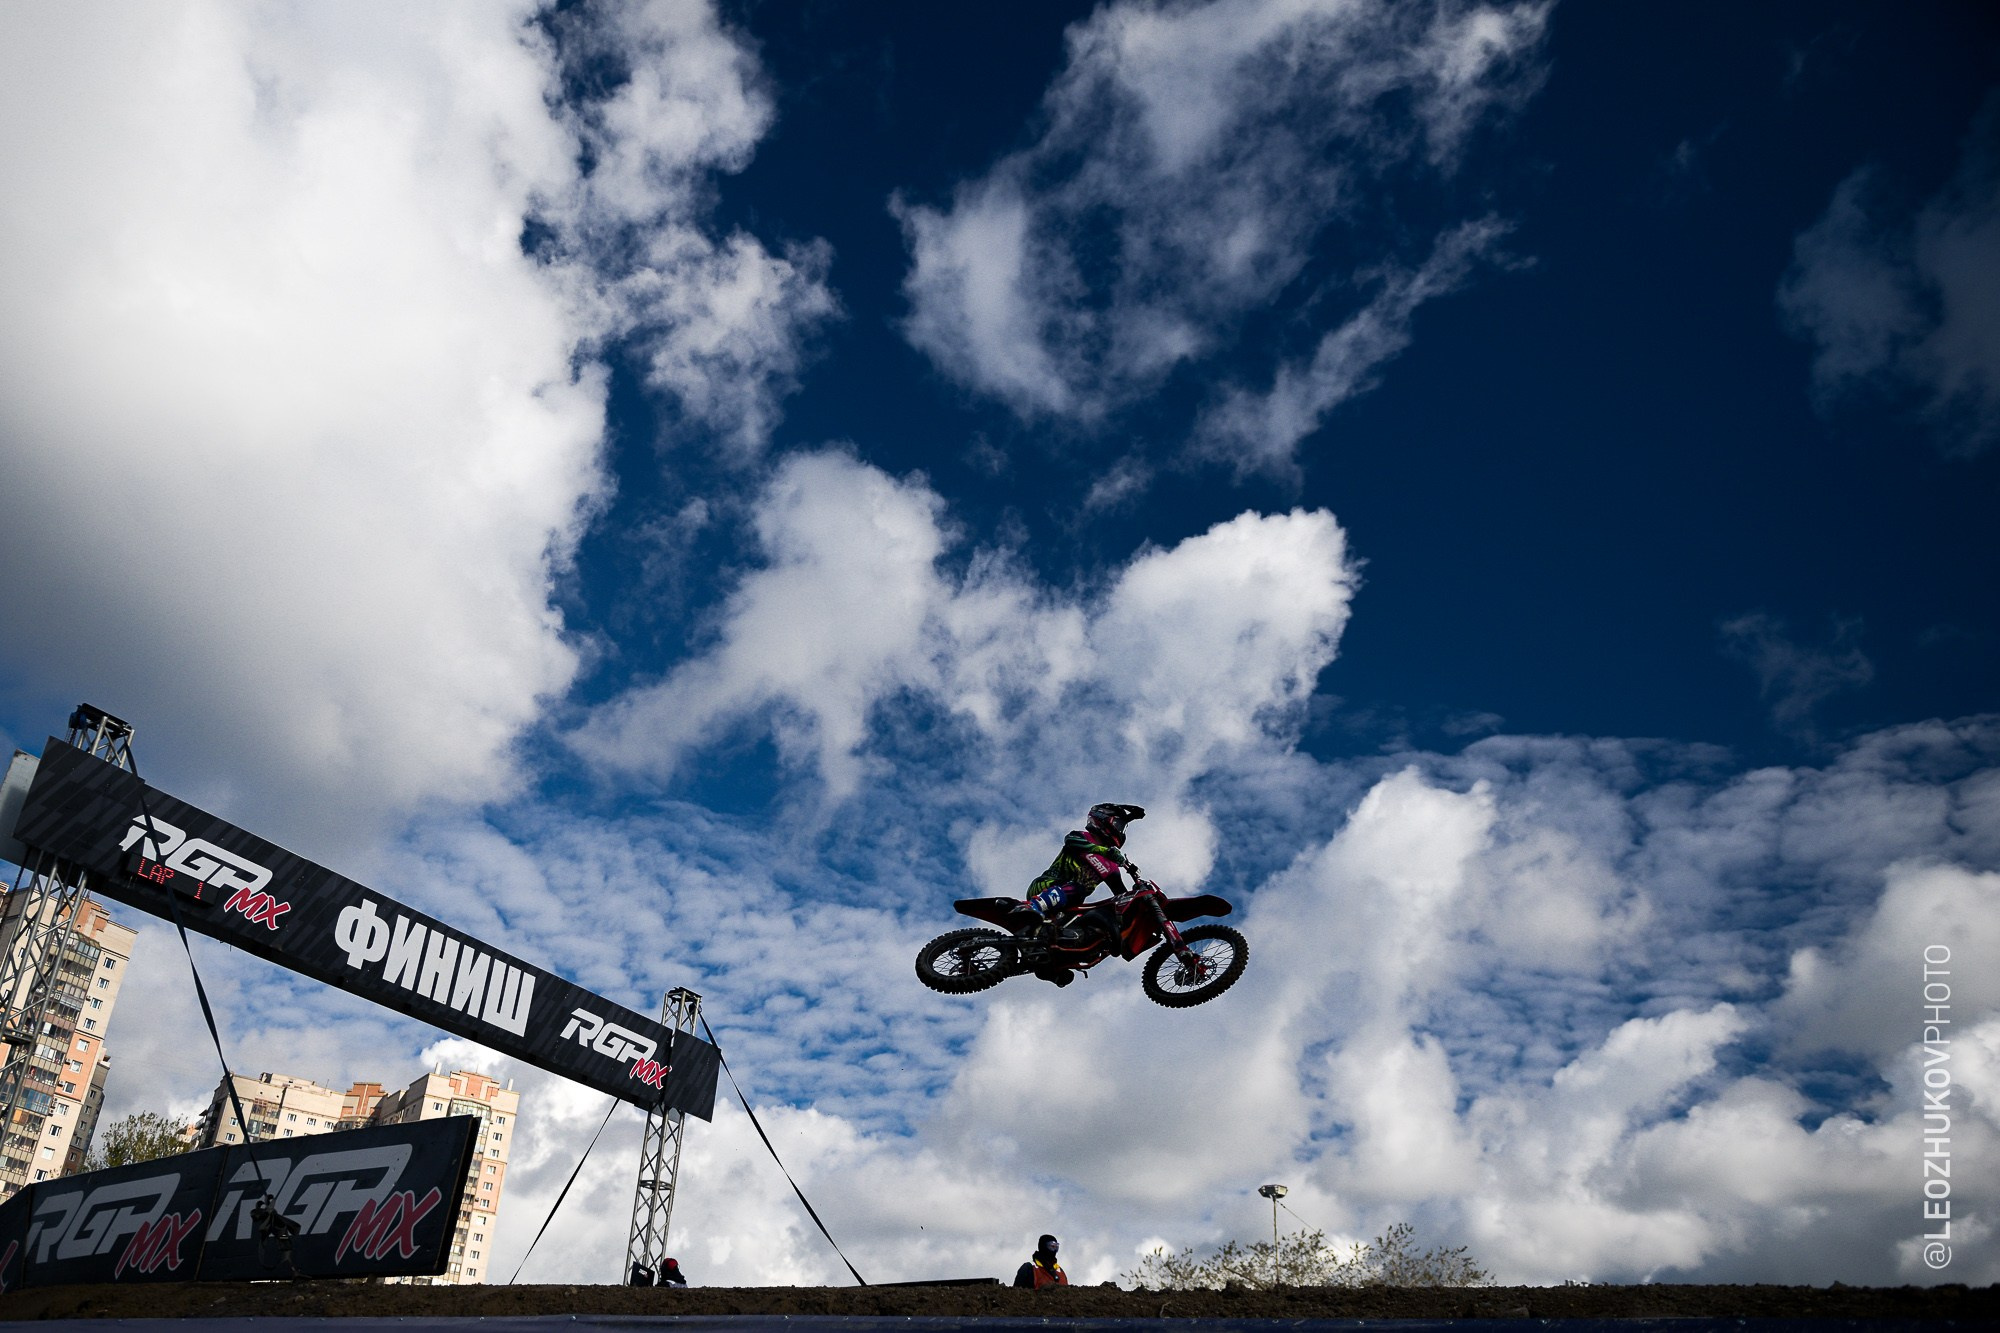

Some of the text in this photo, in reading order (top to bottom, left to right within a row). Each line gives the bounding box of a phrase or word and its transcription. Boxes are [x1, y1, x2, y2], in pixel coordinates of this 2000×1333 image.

[118, 814, 291, 930] RGP MX
[138, 858, 204, 900] LAP 1
[334, 898, 536, 1038] ФИНИШ
[560, 1007, 673, 1089] RGP MX
[25, 1172, 181, 1264] RGP
[115, 1208, 201, 1280] MX
[205, 1143, 442, 1266] RGP MX
